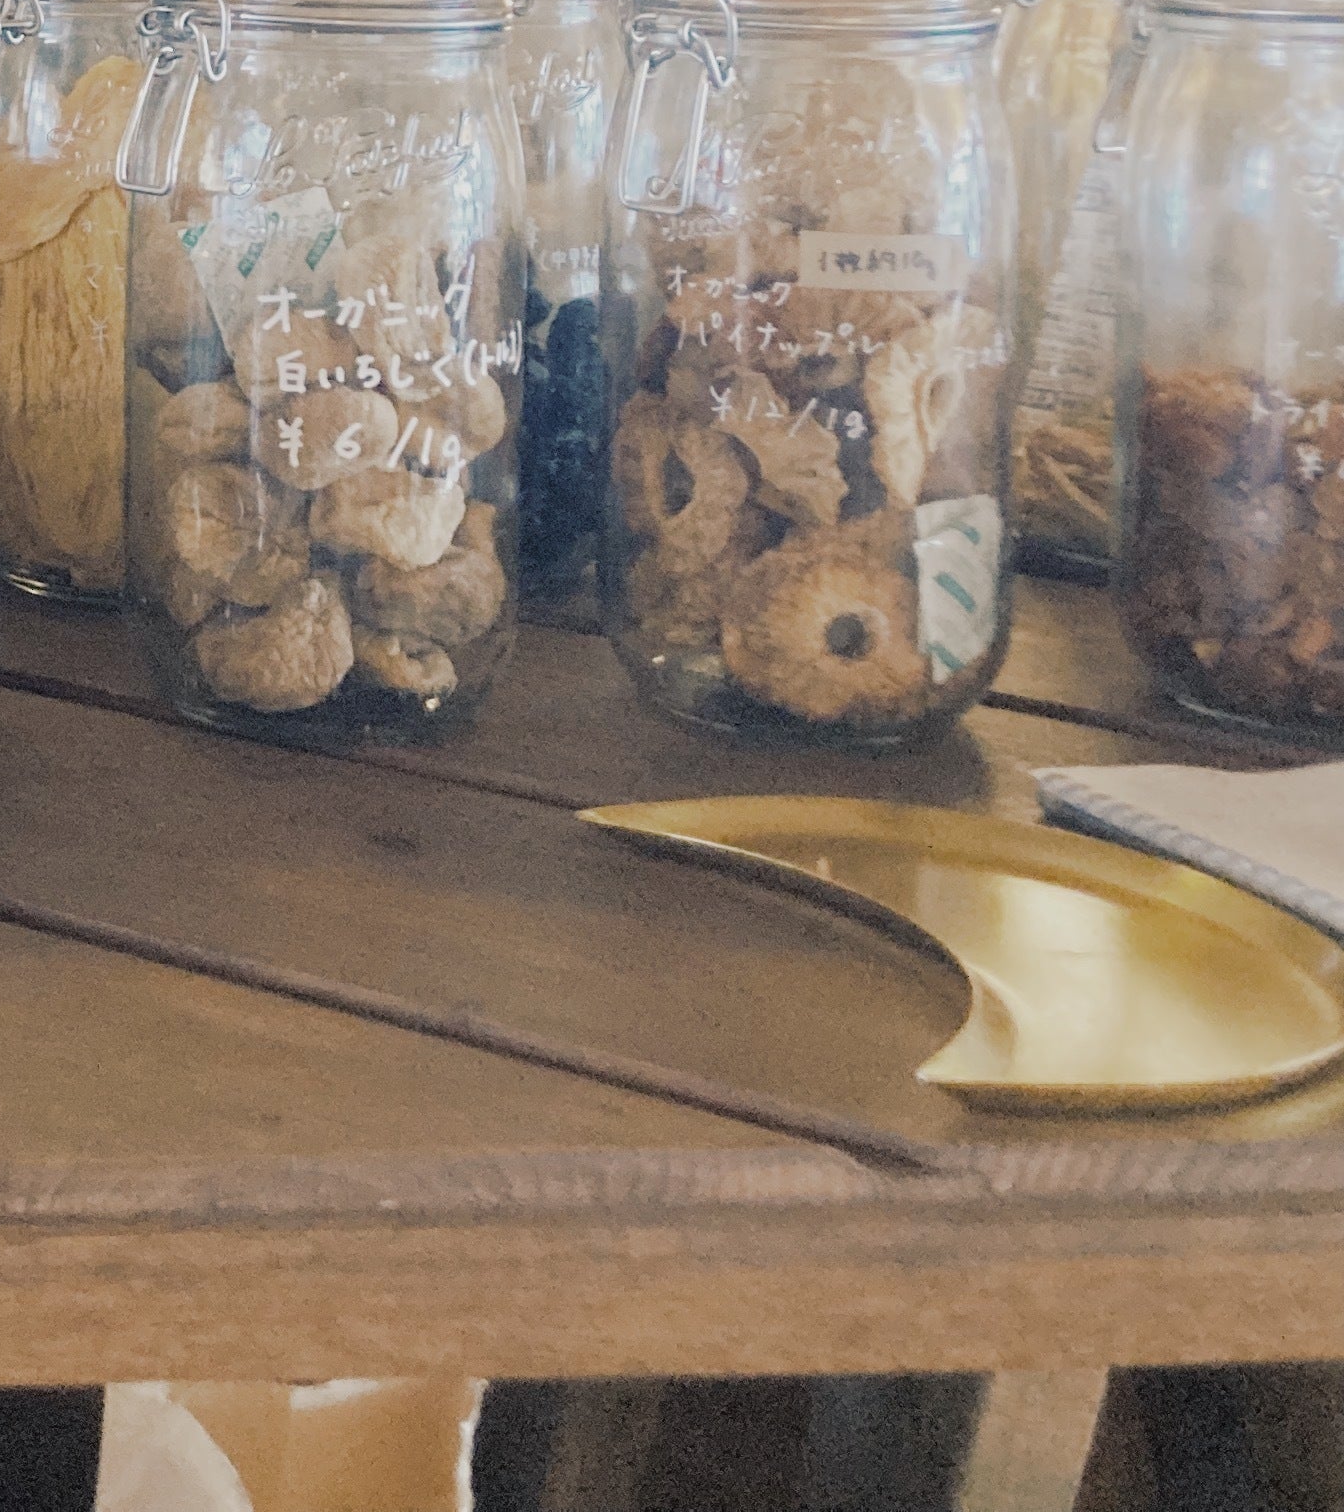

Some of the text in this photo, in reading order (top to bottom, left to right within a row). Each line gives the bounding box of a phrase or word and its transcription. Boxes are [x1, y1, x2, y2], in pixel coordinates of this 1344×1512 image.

[257, 283, 473, 334] オーガニック
[666, 264, 794, 307] オーガニック
[676, 310, 886, 359] パイナップル
[276, 349, 454, 395] 白いちじく
[709, 384, 870, 440] ¥12/1g
